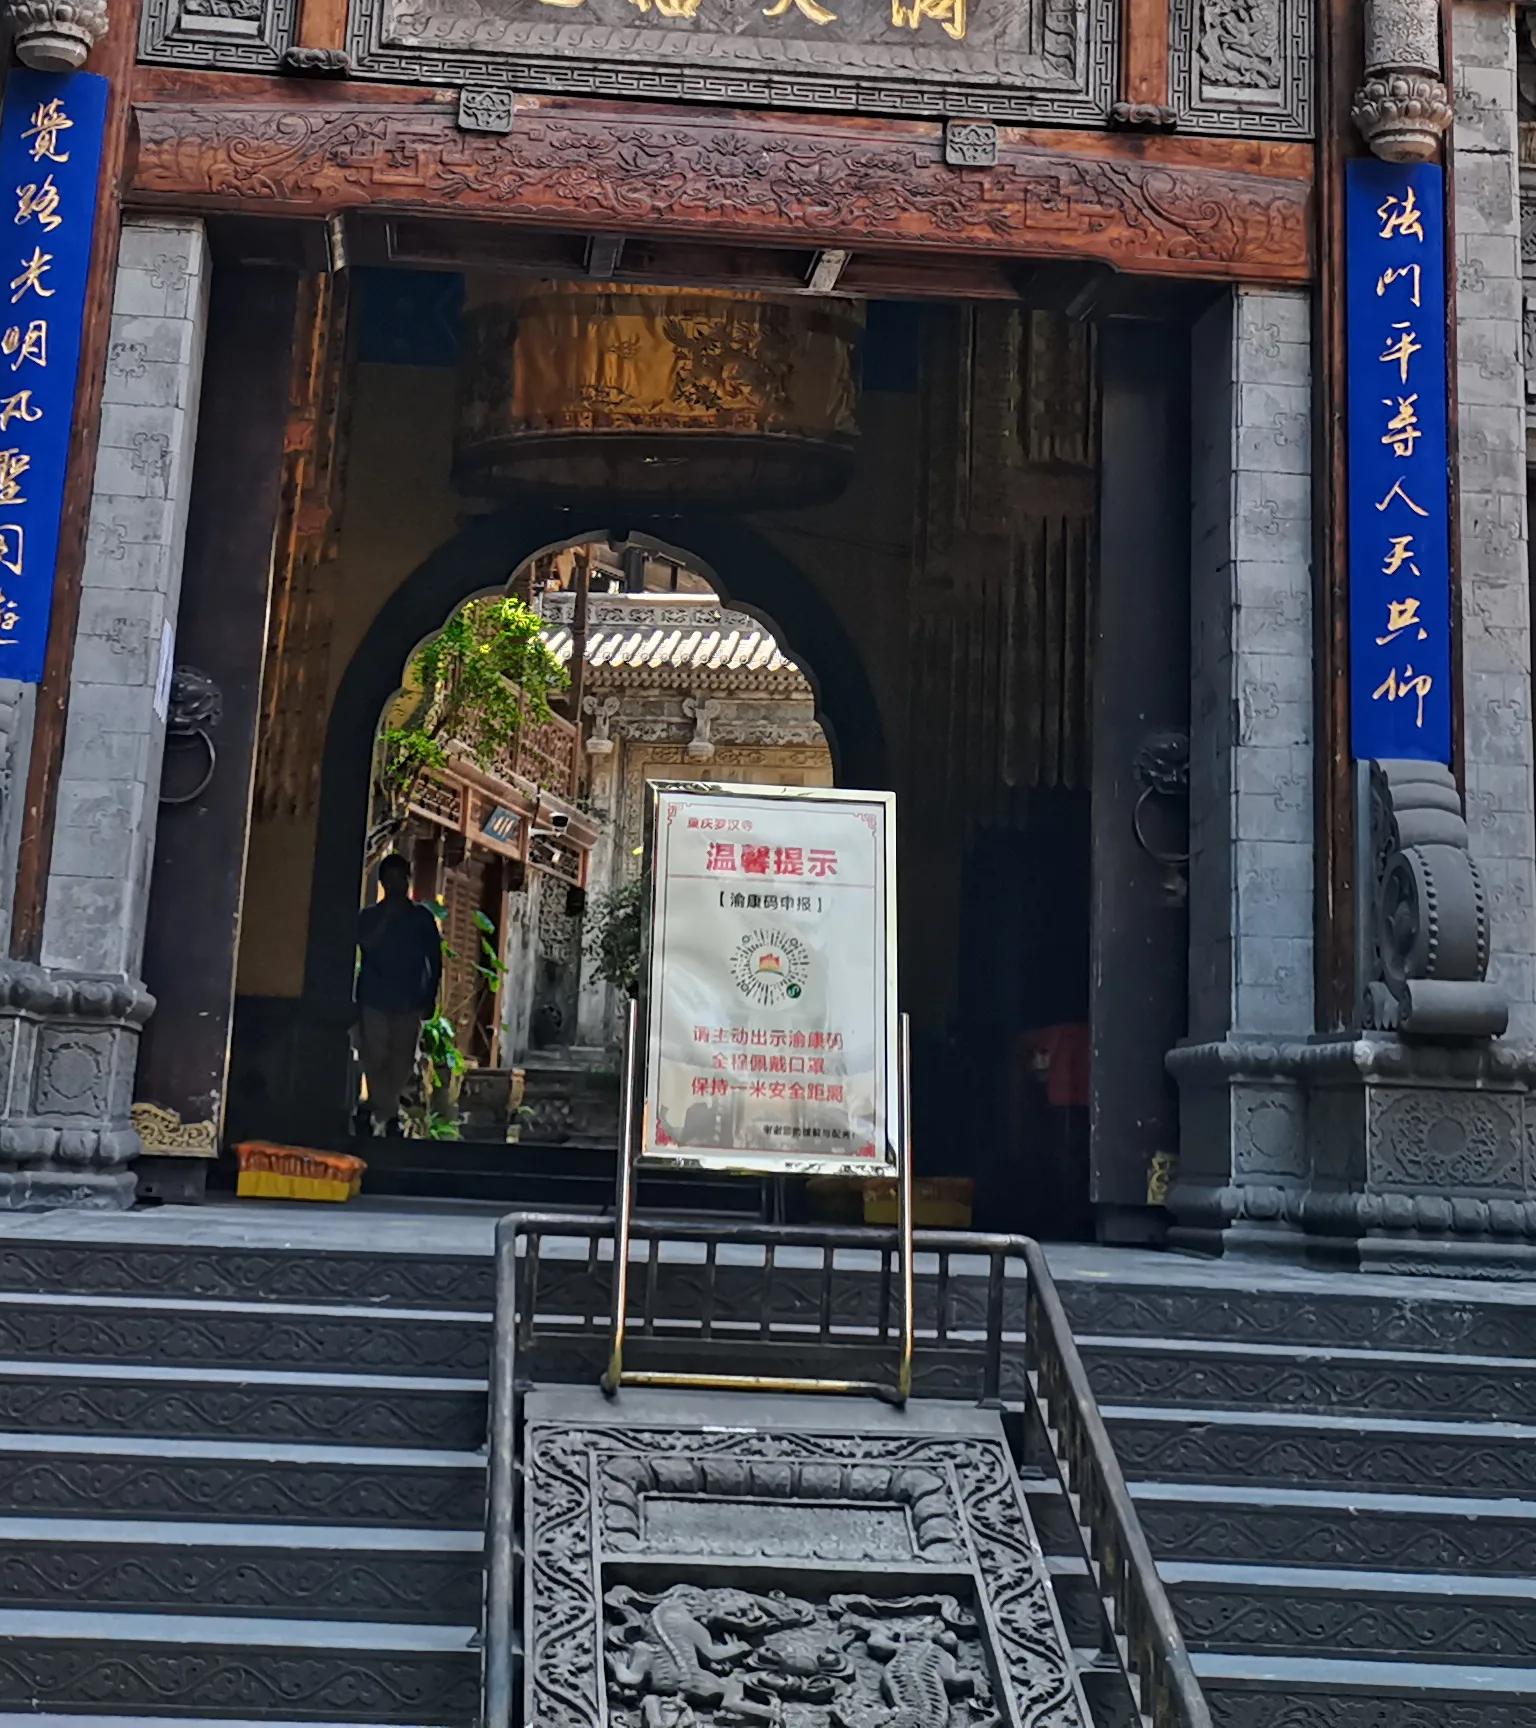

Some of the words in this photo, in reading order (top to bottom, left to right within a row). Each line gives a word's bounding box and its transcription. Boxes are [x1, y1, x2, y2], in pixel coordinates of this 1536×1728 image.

[706, 841, 838, 878] 温馨提示
[693, 1025, 844, 1050] 请主动出示渝康码
[691, 1075, 844, 1104] 保持一米安全距离
